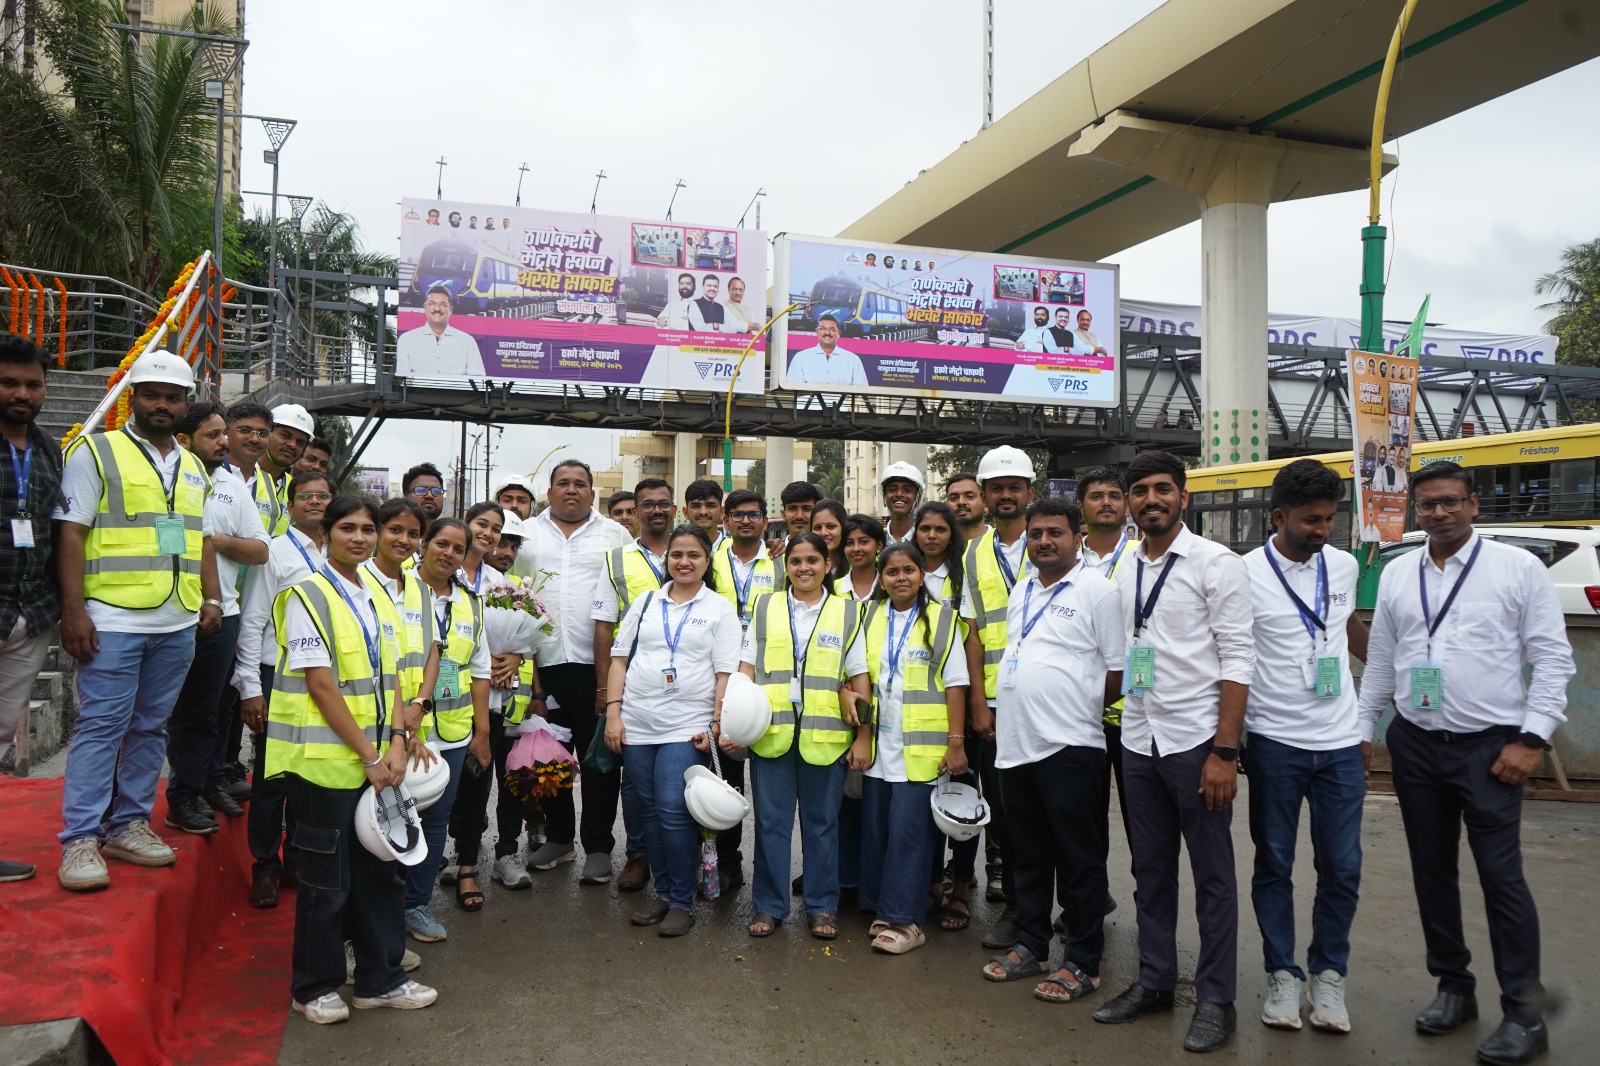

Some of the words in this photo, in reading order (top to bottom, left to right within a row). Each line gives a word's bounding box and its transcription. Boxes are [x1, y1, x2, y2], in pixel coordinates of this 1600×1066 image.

[564, 253, 609, 273] स्वप्न
[517, 268, 562, 290] अखेर
[563, 274, 618, 294] साकार
[905, 307, 942, 323] अखेर
[943, 311, 985, 327] साकार
[561, 347, 577, 358] ठाणे
[714, 363, 741, 377] PRS
[1064, 379, 1089, 391] PRS
[218, 493, 234, 504] PRS
[1333, 593, 1347, 603] PRS
[1058, 606, 1076, 617] PRS
[692, 618, 708, 626] PRS
[301, 637, 321, 648] PRS
[827, 635, 841, 644] PRS
[915, 650, 929, 658] PRS
